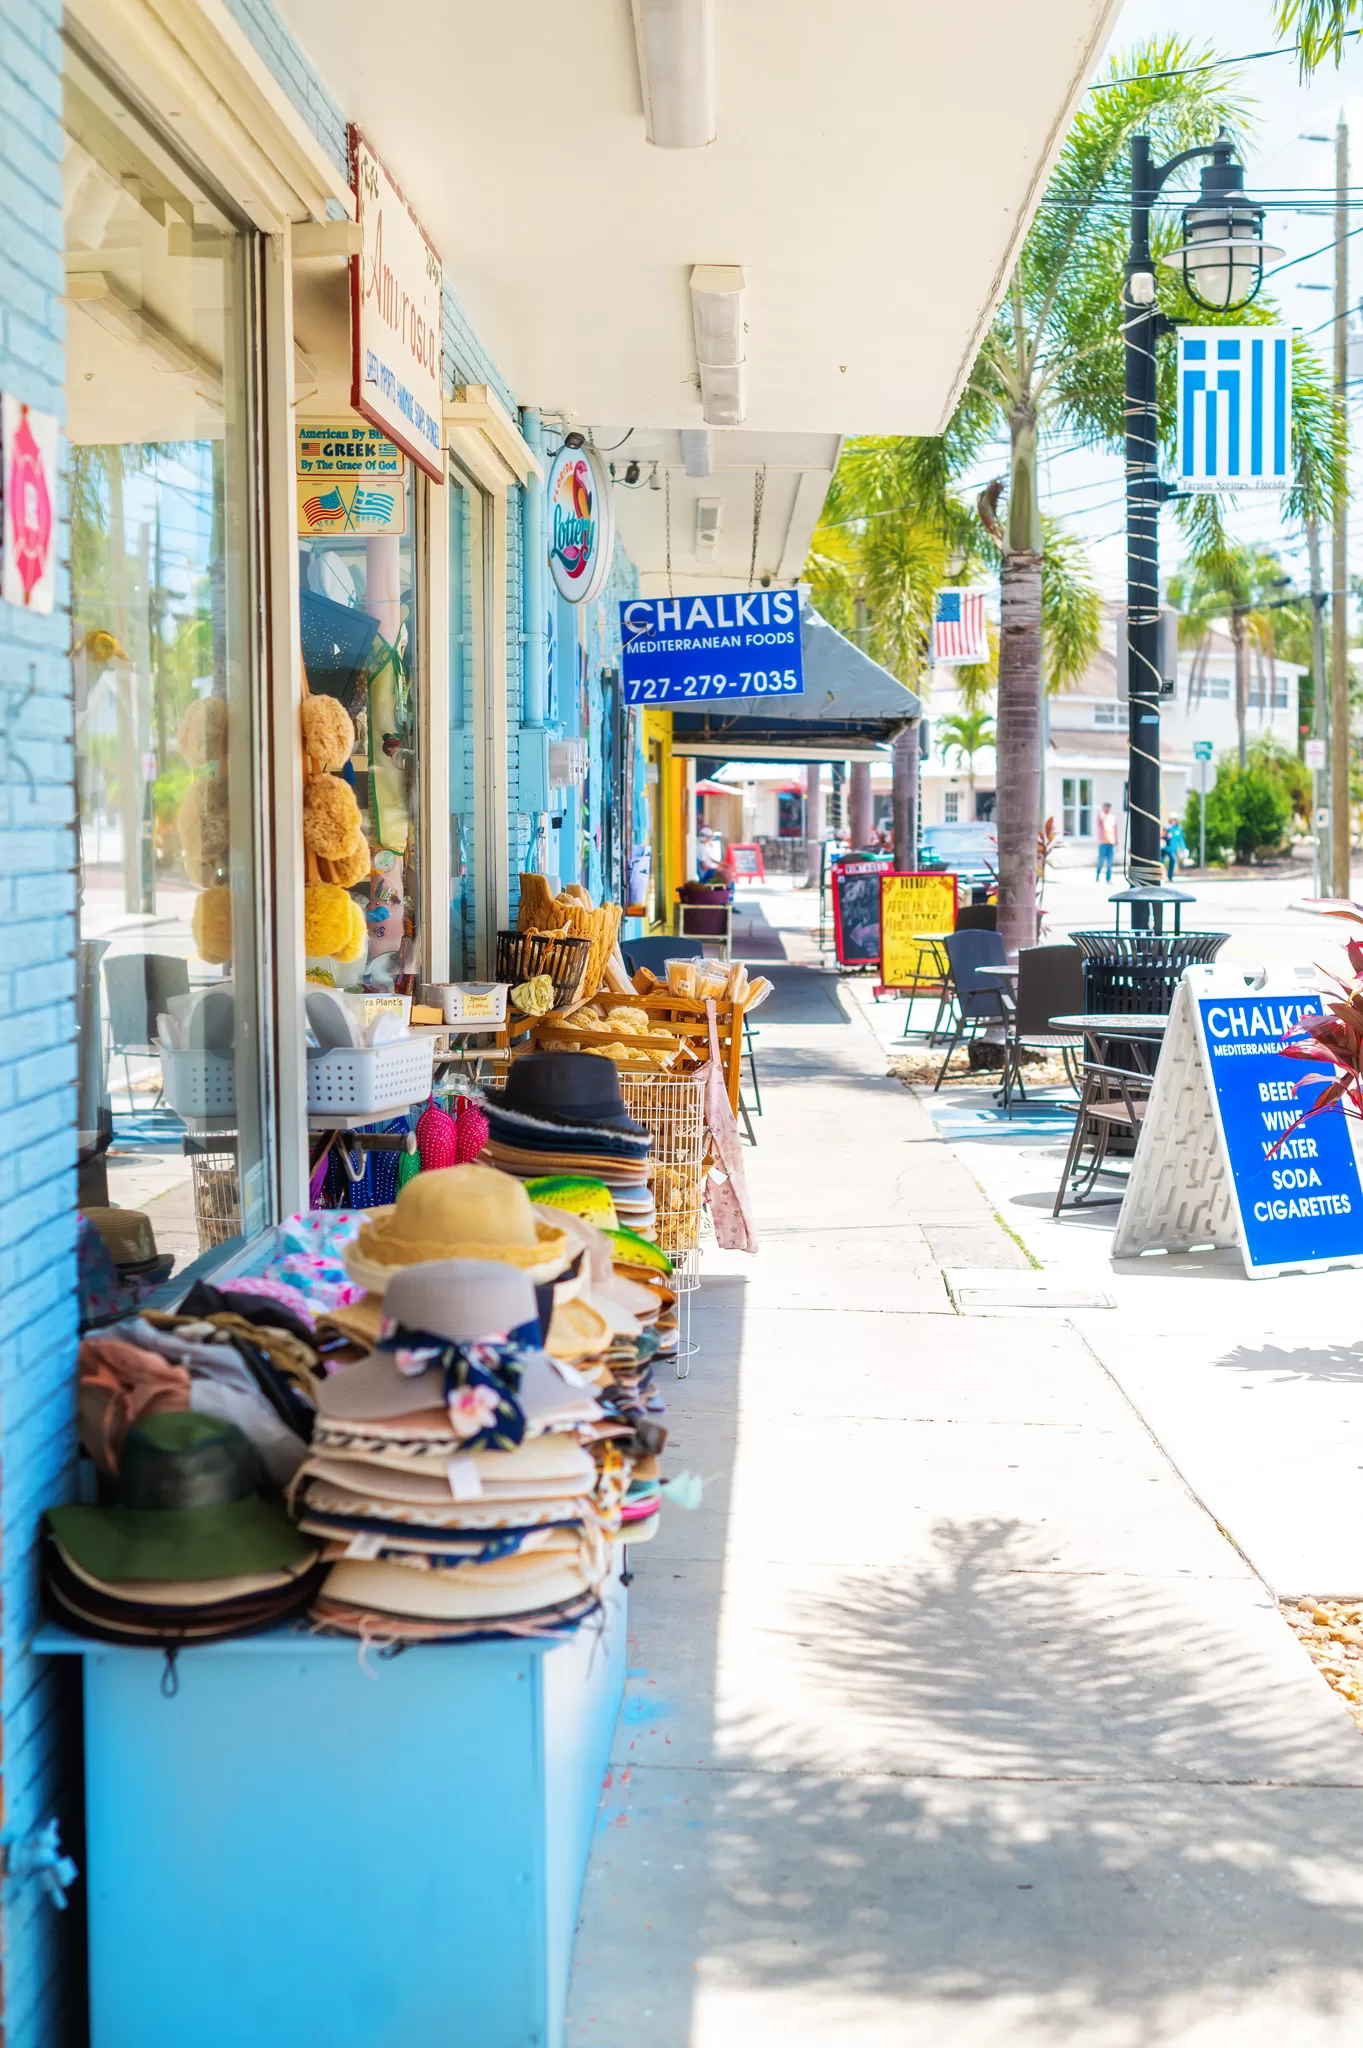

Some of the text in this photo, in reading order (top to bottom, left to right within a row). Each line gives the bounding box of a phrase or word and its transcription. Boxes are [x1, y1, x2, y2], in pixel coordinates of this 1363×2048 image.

[298, 428, 385, 441] American By Bir
[323, 442, 377, 457] GREEK
[300, 460, 397, 472] By The Grace Of God
[553, 460, 573, 503] FLORIDA
[1183, 481, 1212, 490] Tarpon
[1255, 480, 1286, 489] Florida
[551, 503, 595, 567] Lottery
[623, 592, 794, 634] CHALKIS
[627, 631, 795, 654] MEDITERRANEAN FOODS
[629, 669, 797, 700] 727-279-7035
[376, 998, 403, 1006] Plant's
[469, 995, 489, 1003] Special
[1213, 1042, 1289, 1057] MEDITERRANEAN
[1258, 1081, 1298, 1102] BEER
[1261, 1110, 1306, 1131] WINE
[1261, 1138, 1318, 1160] WATER
[1271, 1167, 1322, 1190] SODA
[1253, 1194, 1352, 1222] CIGARETTES
